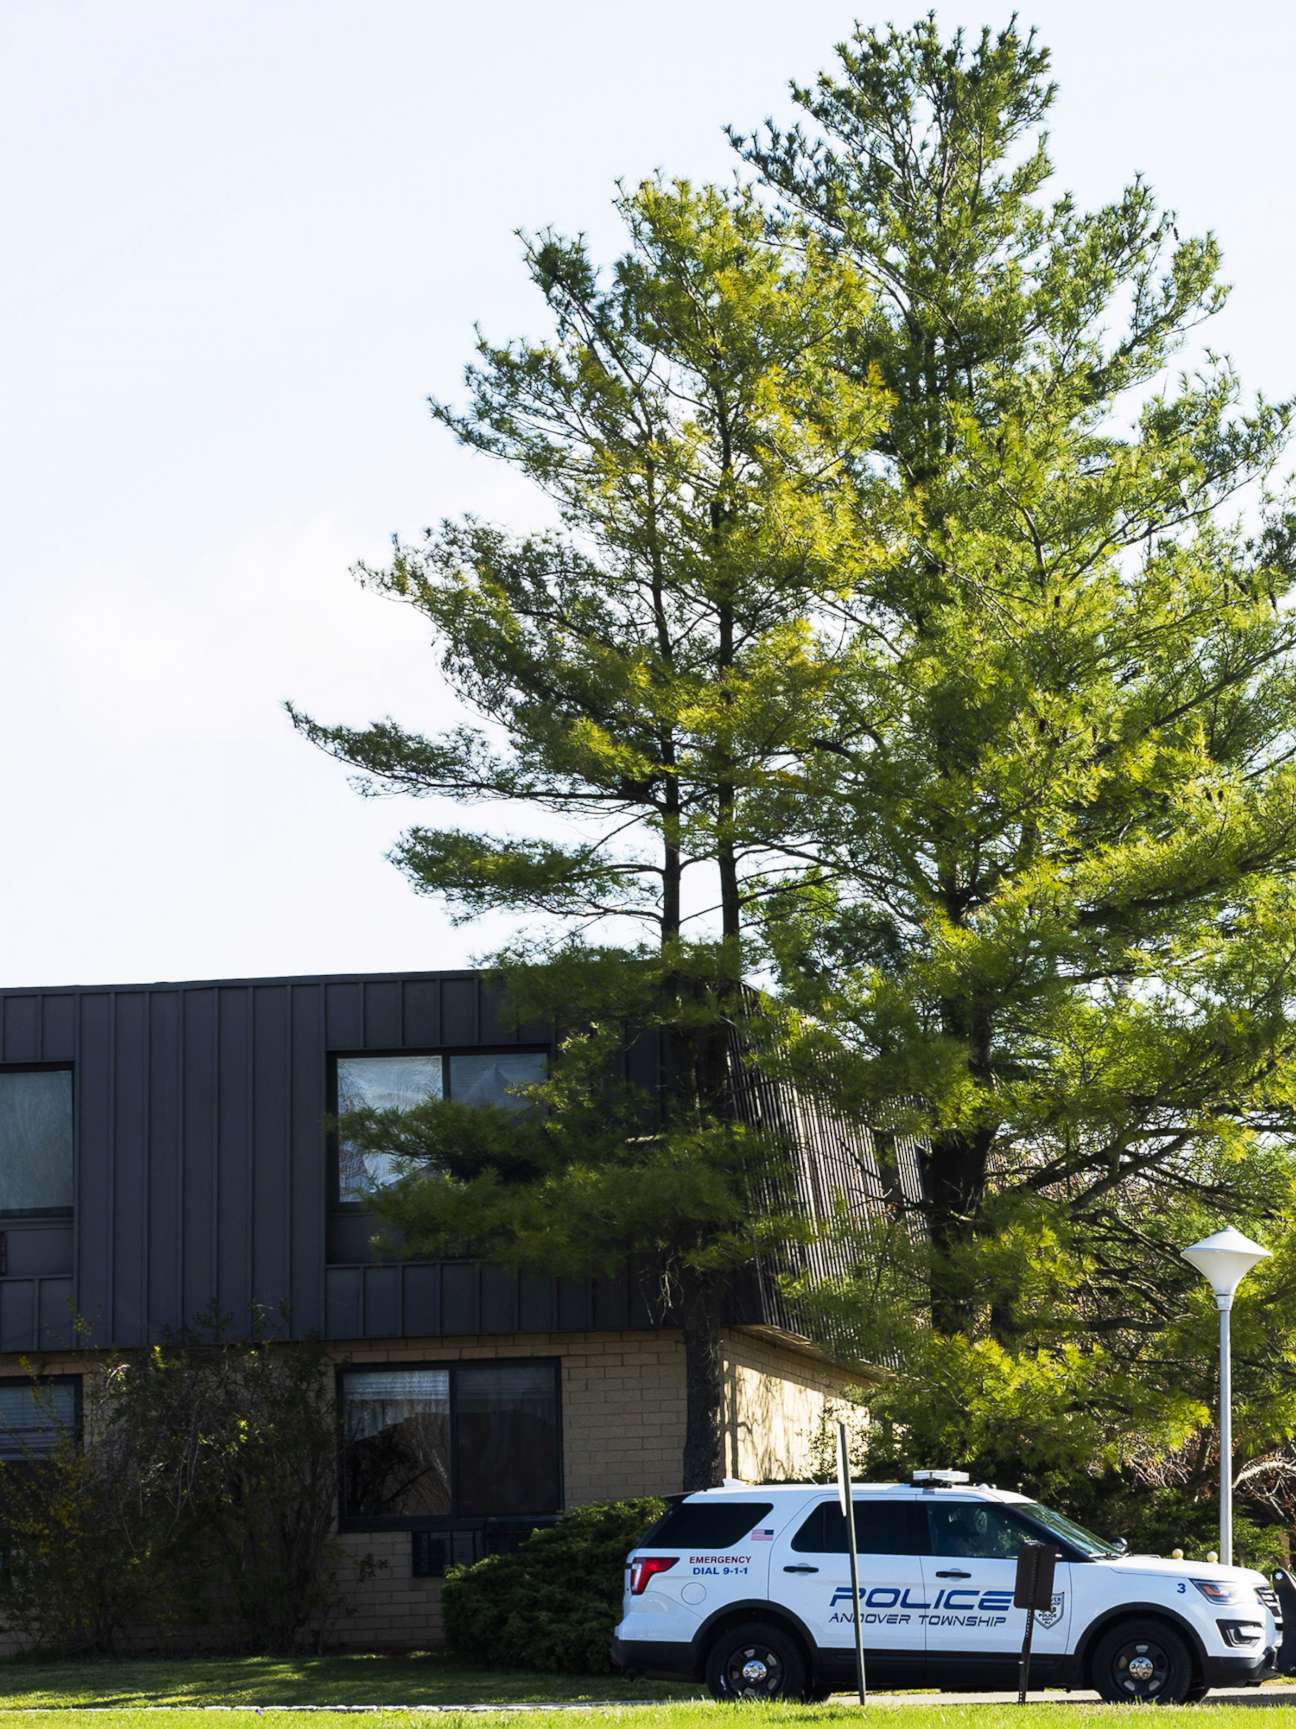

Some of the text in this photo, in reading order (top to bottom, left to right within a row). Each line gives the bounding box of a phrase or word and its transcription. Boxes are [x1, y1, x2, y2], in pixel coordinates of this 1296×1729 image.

[689, 1556, 752, 1564] EMERGENCY
[693, 1567, 748, 1575] DIAL 9-1-1
[1177, 1583, 1186, 1593] 3
[829, 1587, 1015, 1611] POLICE
[918, 1614, 1007, 1627] TOWNSHIP
